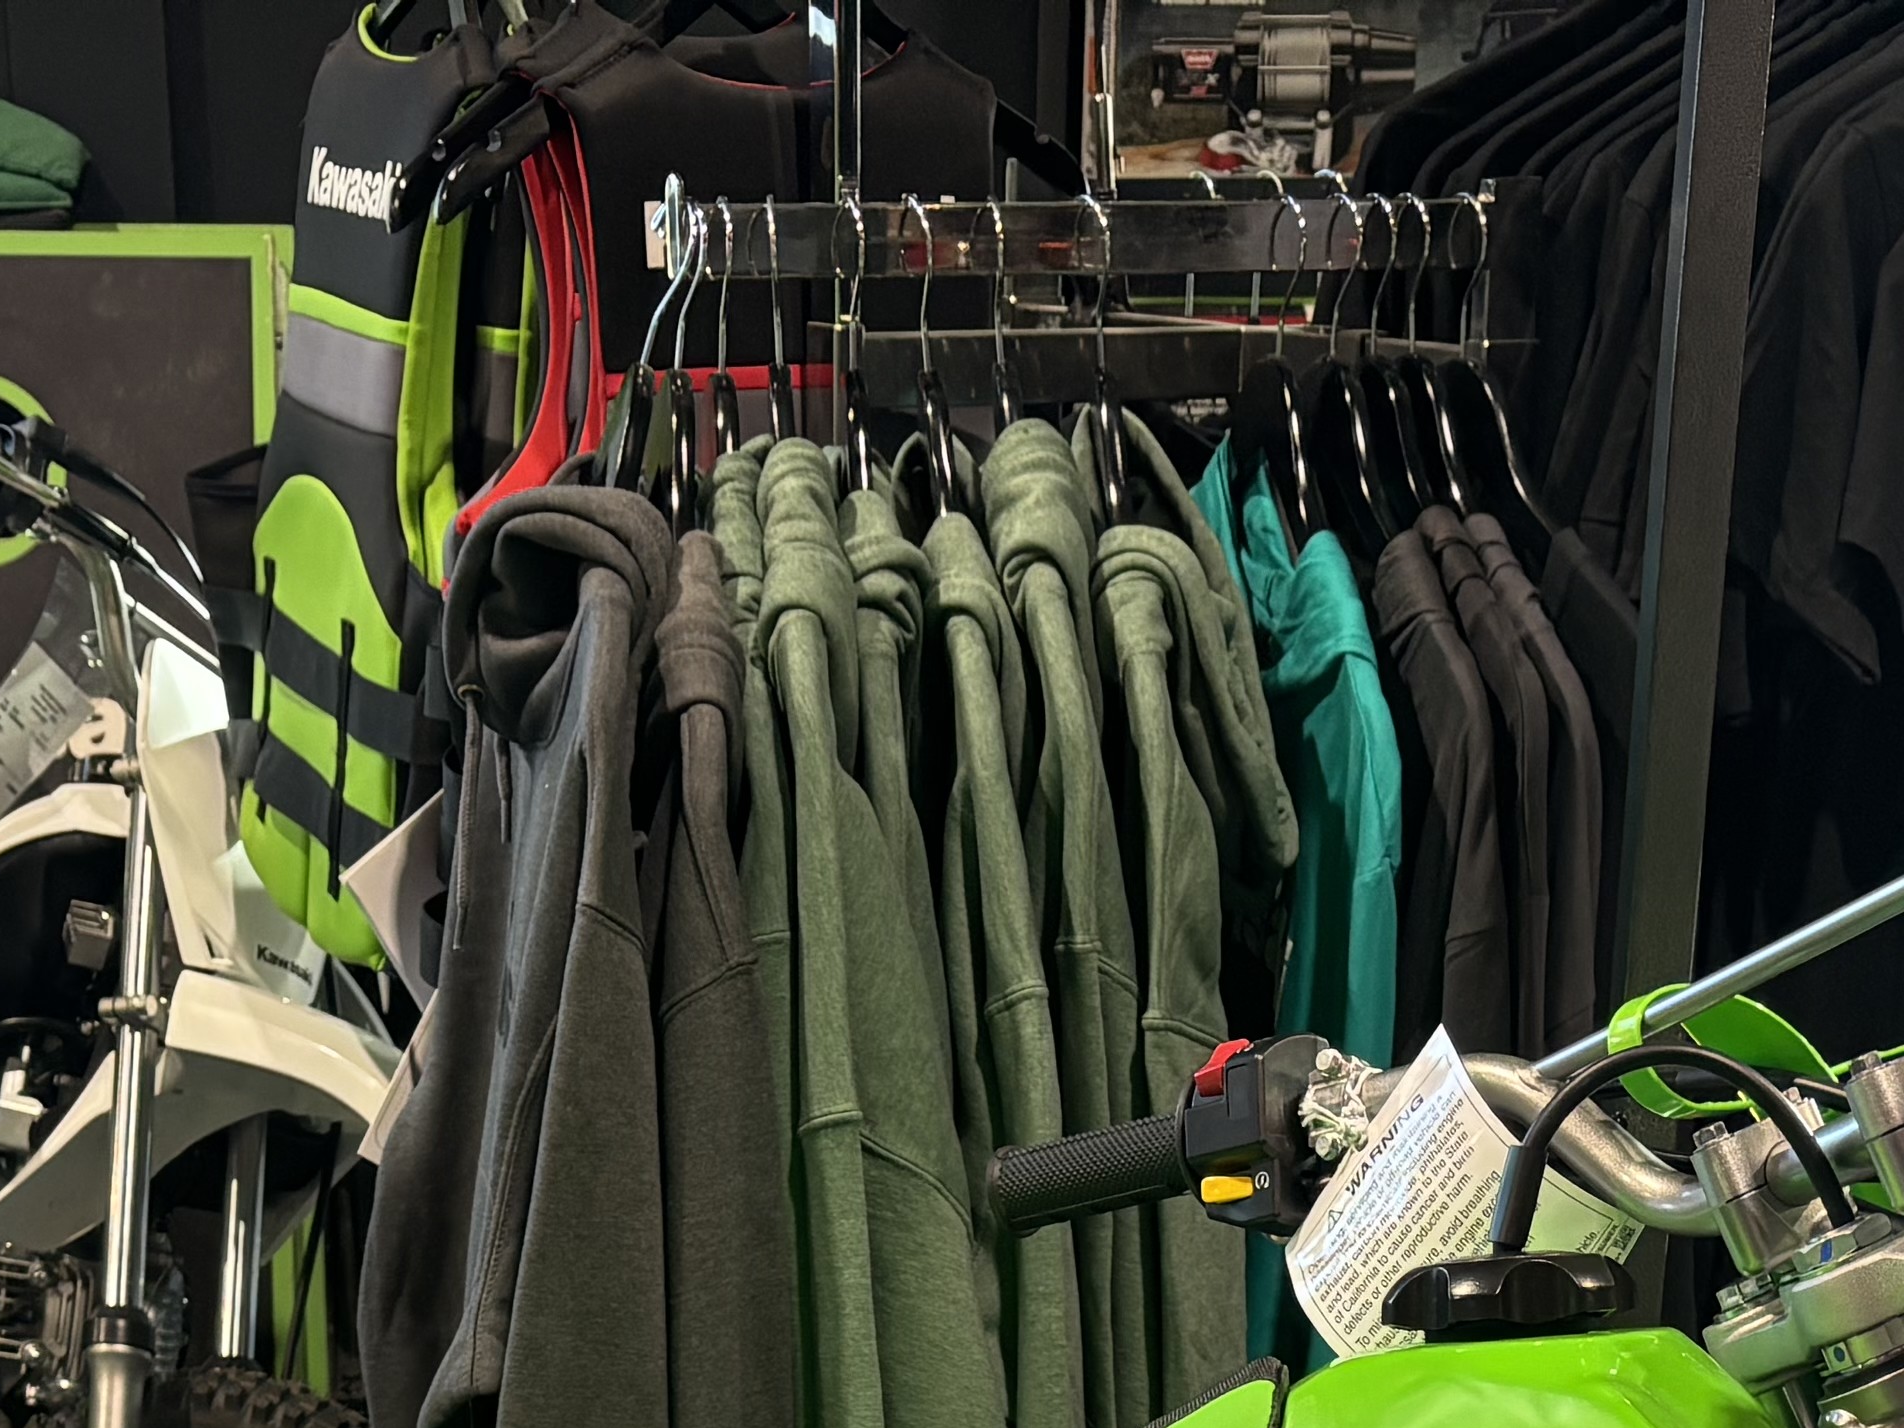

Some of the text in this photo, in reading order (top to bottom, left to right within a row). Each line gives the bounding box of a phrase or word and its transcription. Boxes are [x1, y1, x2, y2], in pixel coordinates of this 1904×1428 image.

[1345, 1093, 1425, 1196] WARNING
[1419, 1120, 1464, 1176] phthalates,
[1437, 1098, 1464, 1133] engine
[1327, 1291, 1342, 1313] and
[1360, 1239, 1384, 1268] which
[1383, 1222, 1397, 1239] are
[1422, 1177, 1432, 1188] to
[1431, 1159, 1446, 1177] the
[1445, 1131, 1468, 1159] State
[1334, 1309, 1344, 1324] of
[1342, 1267, 1380, 1312] California
[1377, 1255, 1388, 1267] to
[1388, 1224, 1412, 1255] cause
[1411, 1190, 1438, 1225] cancer
[1438, 1168, 1455, 1191] and
[1452, 1146, 1474, 1170] birth
[1344, 1299, 1372, 1335] defects
[1371, 1287, 1381, 1299] or
[1380, 1260, 1402, 1287] other
[1401, 1201, 1450, 1261] reproductive
[1446, 1172, 1473, 1202] harm.
[1355, 1336, 1370, 1350] To
[1439, 1215, 1463, 1246] avoid
[1458, 1171, 1502, 1219] breathing
[1455, 1217, 1484, 1252] engine
